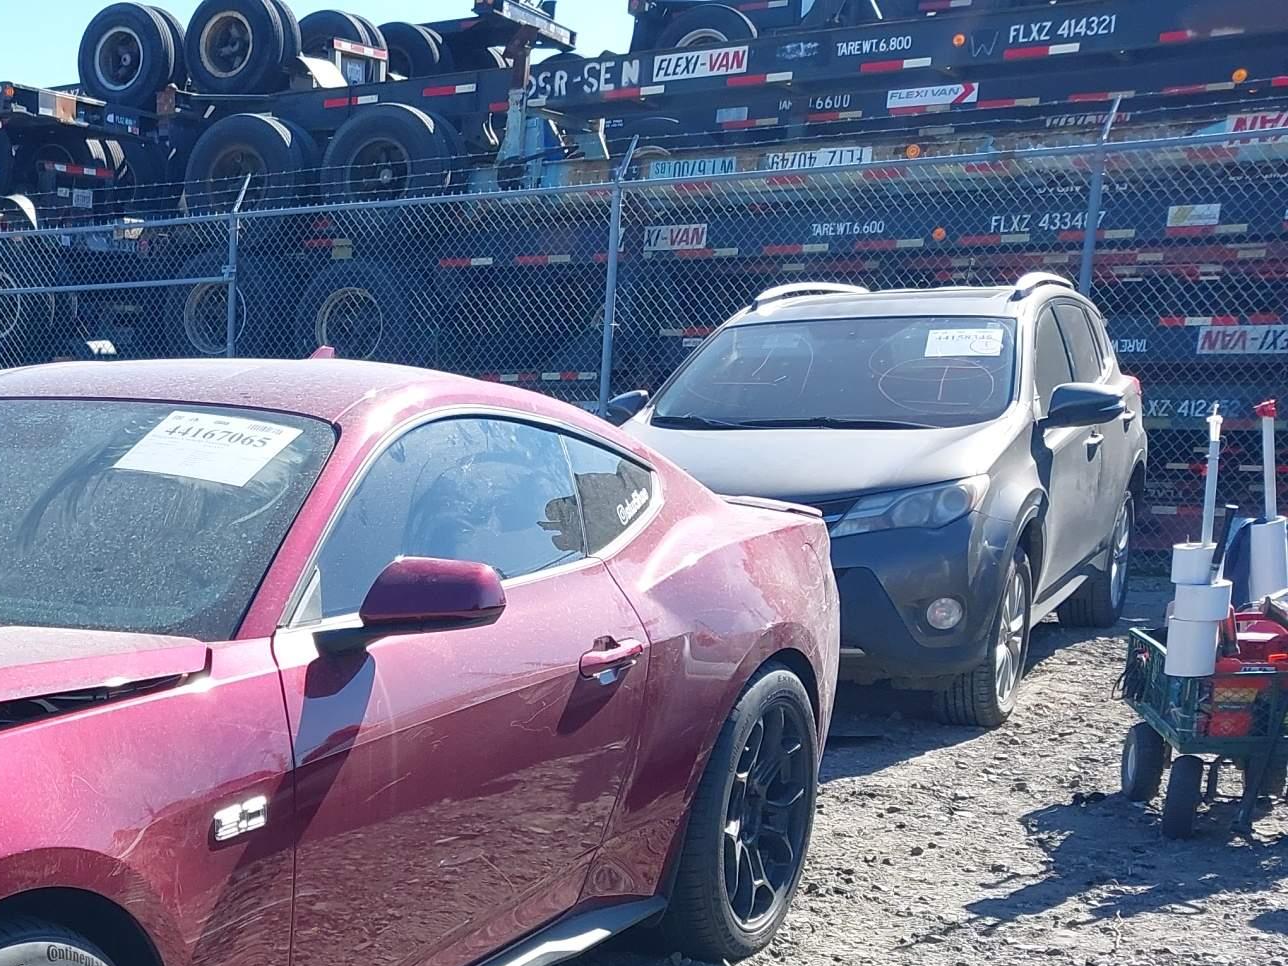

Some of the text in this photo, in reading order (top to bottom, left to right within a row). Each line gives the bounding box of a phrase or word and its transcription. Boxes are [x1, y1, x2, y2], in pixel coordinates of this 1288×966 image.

[1009, 15, 1117, 43] FLXZ 414321
[655, 50, 746, 77] FLEXI-VAN
[990, 214, 1032, 233] FLXZ
[165, 424, 272, 448] 44167065
